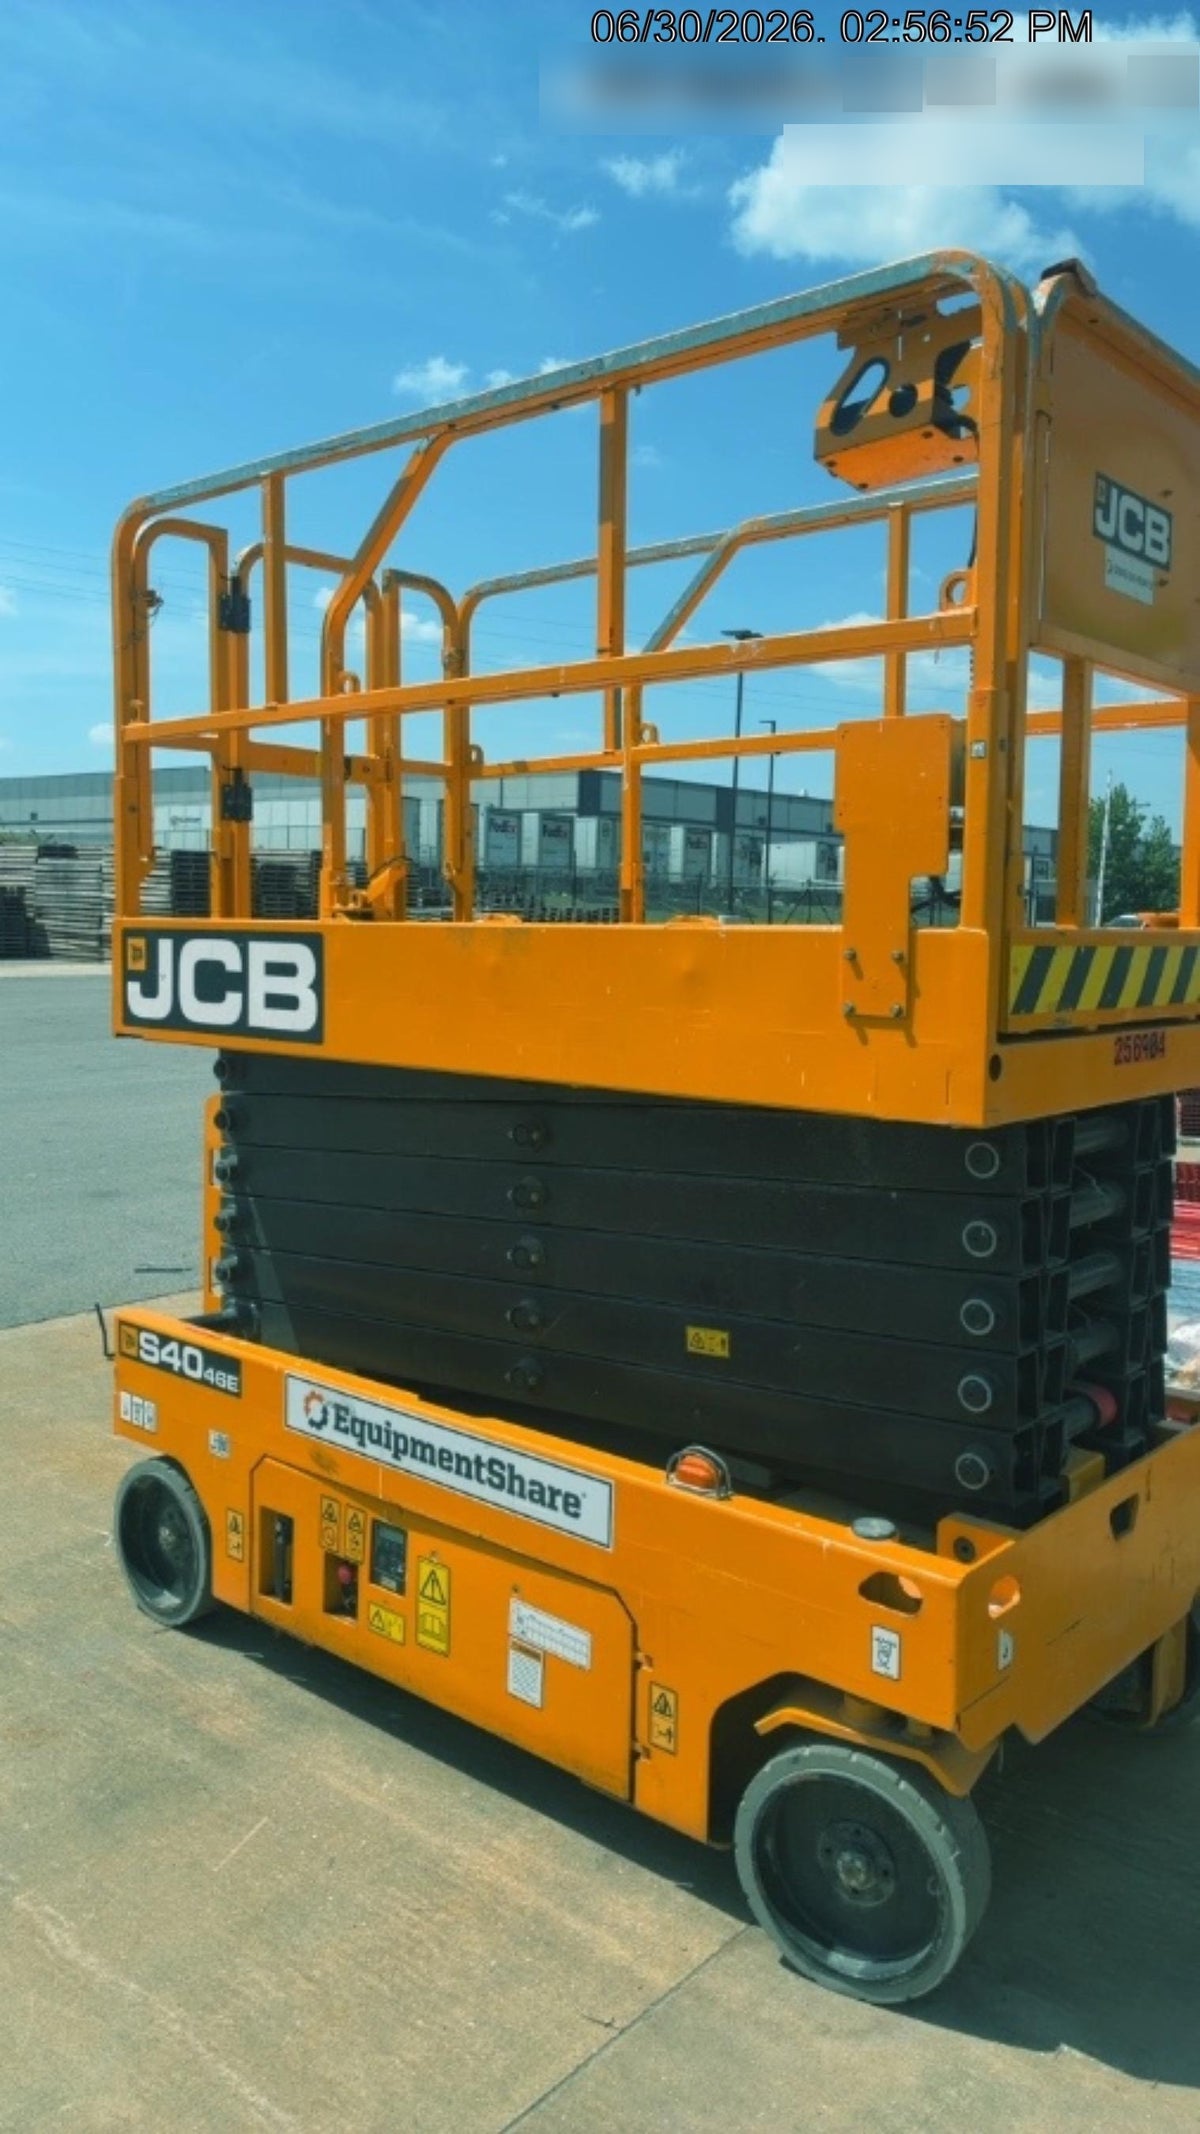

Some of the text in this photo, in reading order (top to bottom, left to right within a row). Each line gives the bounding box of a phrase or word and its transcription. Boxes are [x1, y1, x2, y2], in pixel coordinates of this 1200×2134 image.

[1095, 486, 1170, 564] JCB
[127, 938, 319, 1032] JCB
[332, 1402, 582, 1520] EquipmentShare
